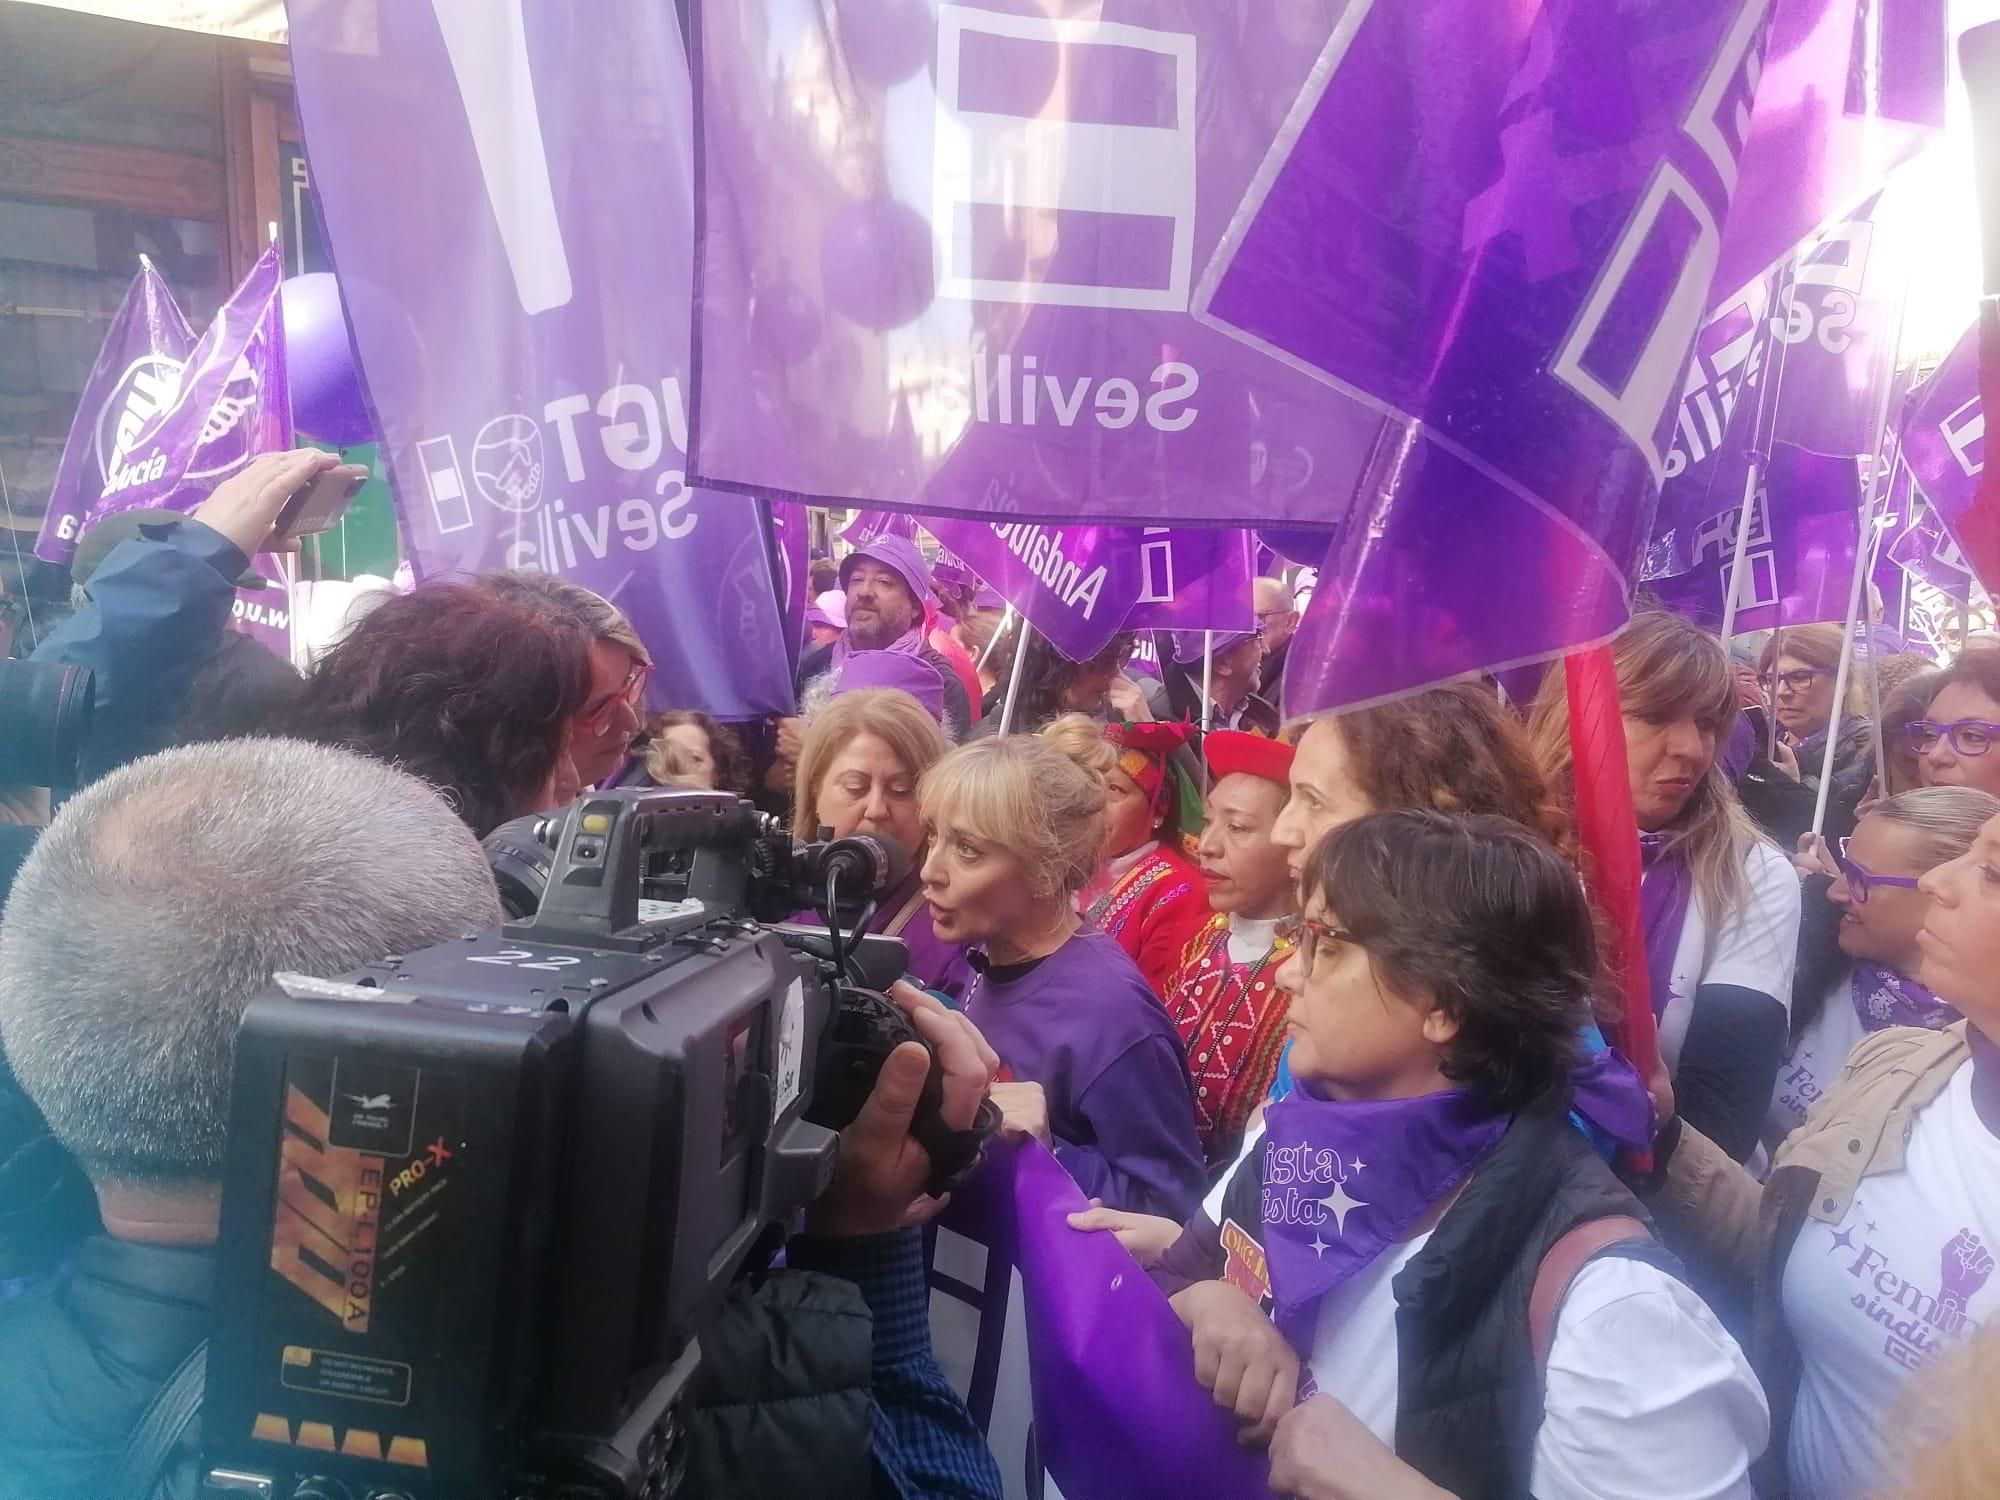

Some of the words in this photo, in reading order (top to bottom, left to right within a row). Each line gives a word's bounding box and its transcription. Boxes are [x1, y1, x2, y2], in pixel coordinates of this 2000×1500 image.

[466, 950, 581, 971] 22
[389, 1136, 452, 1197] PRO-X
[1261, 1187, 1328, 1226] ista
